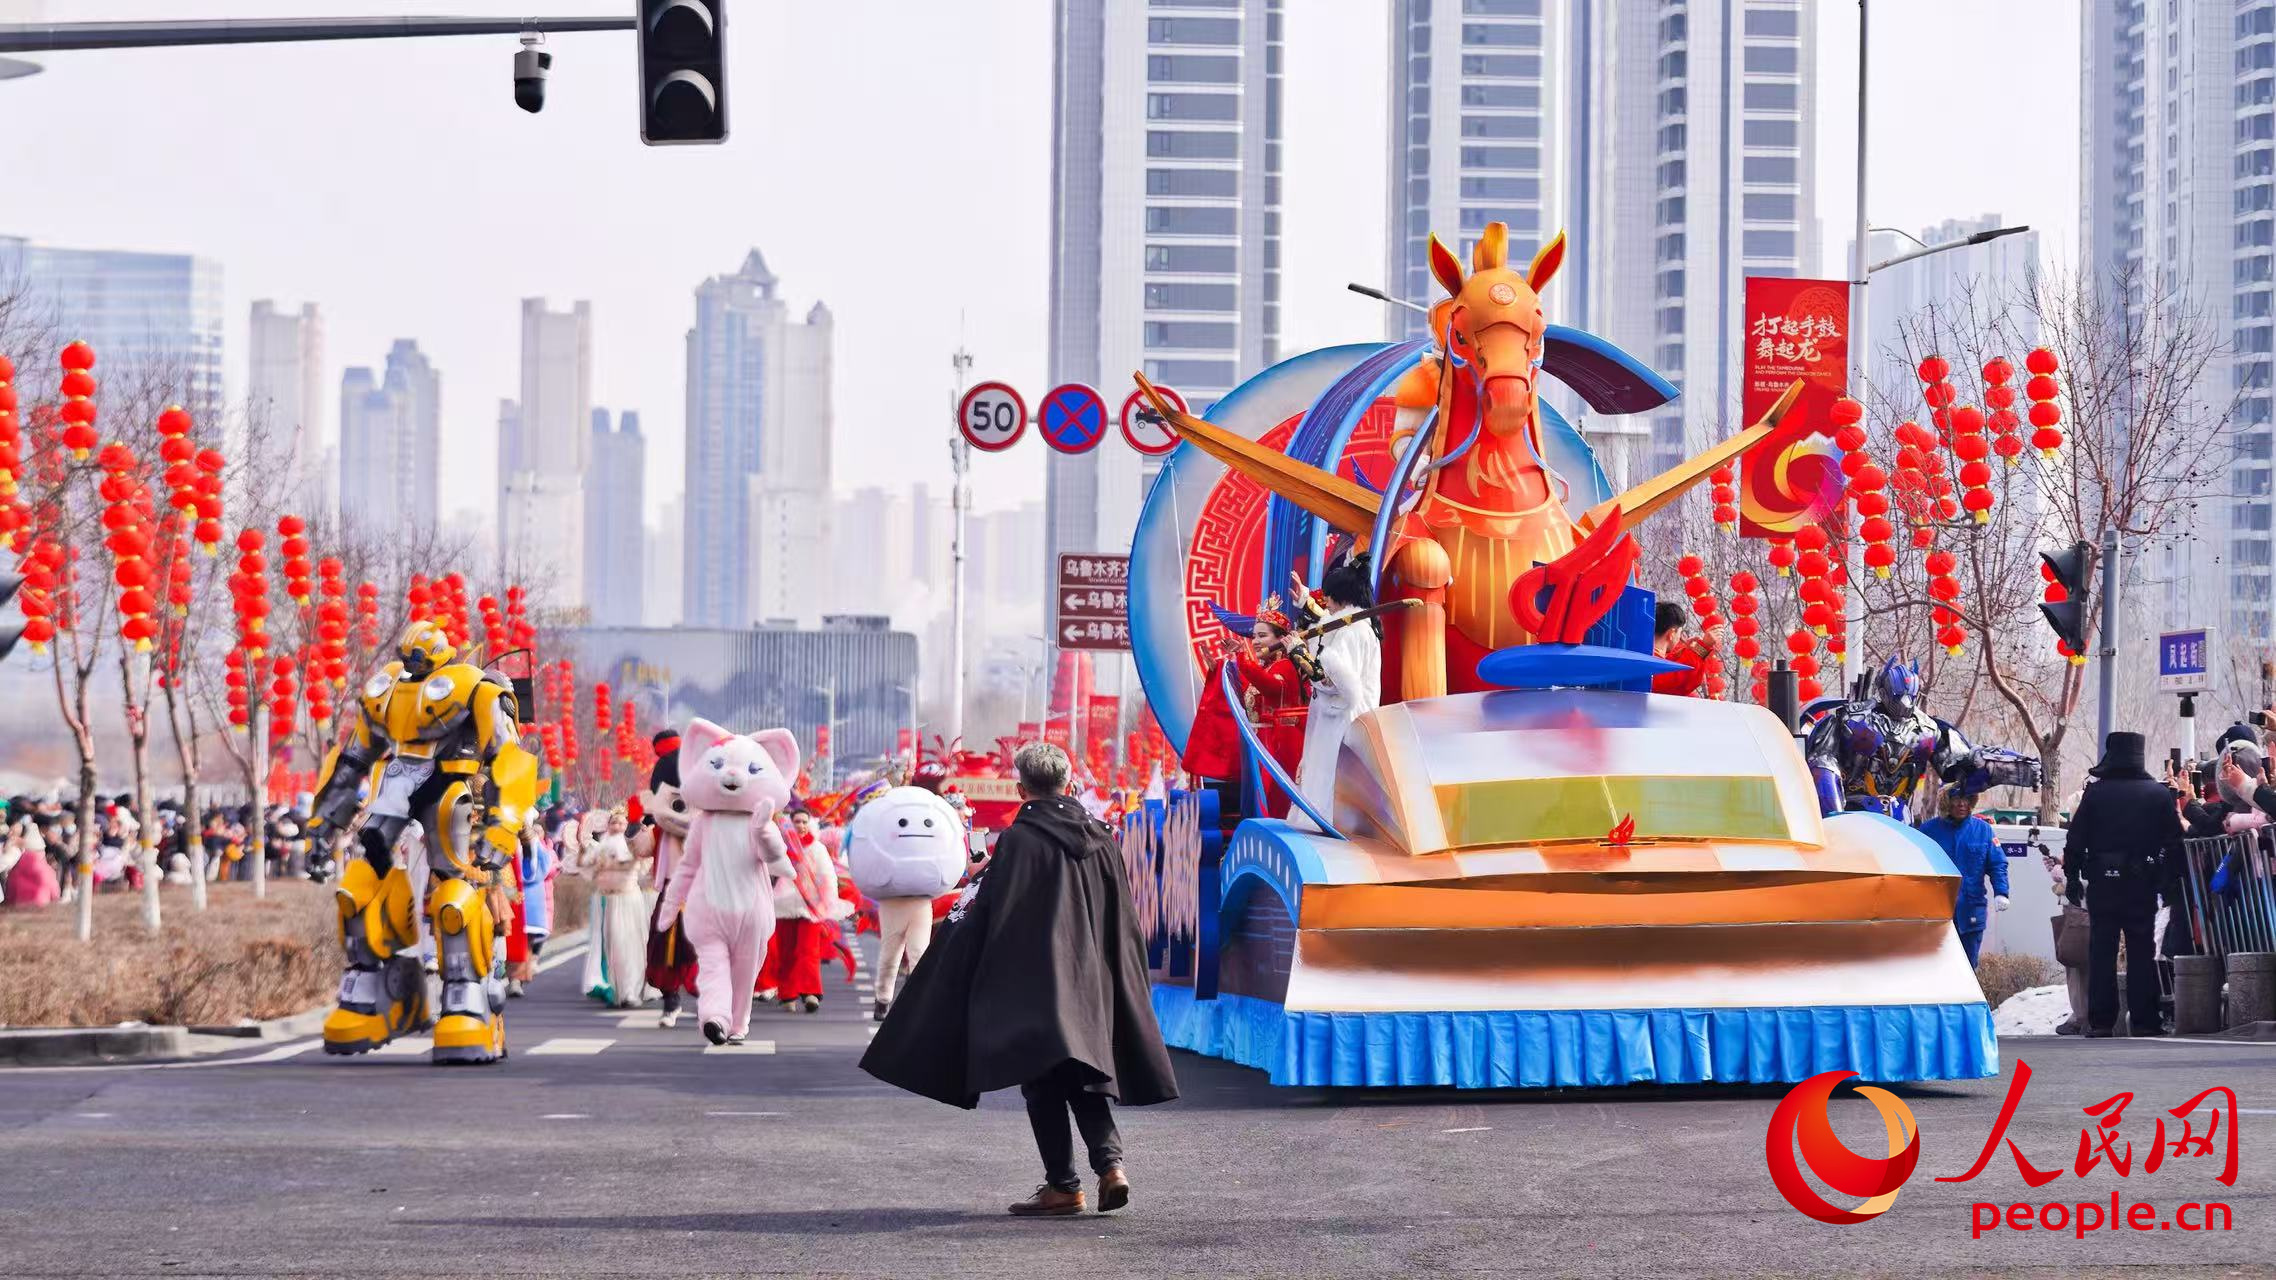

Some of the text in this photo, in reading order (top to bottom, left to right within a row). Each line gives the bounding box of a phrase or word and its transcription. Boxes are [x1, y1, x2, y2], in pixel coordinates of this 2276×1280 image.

[1752, 312, 1842, 337] 打起手鼓
[1756, 337, 1822, 362] 舞起龙
[973, 401, 1015, 432] 50
